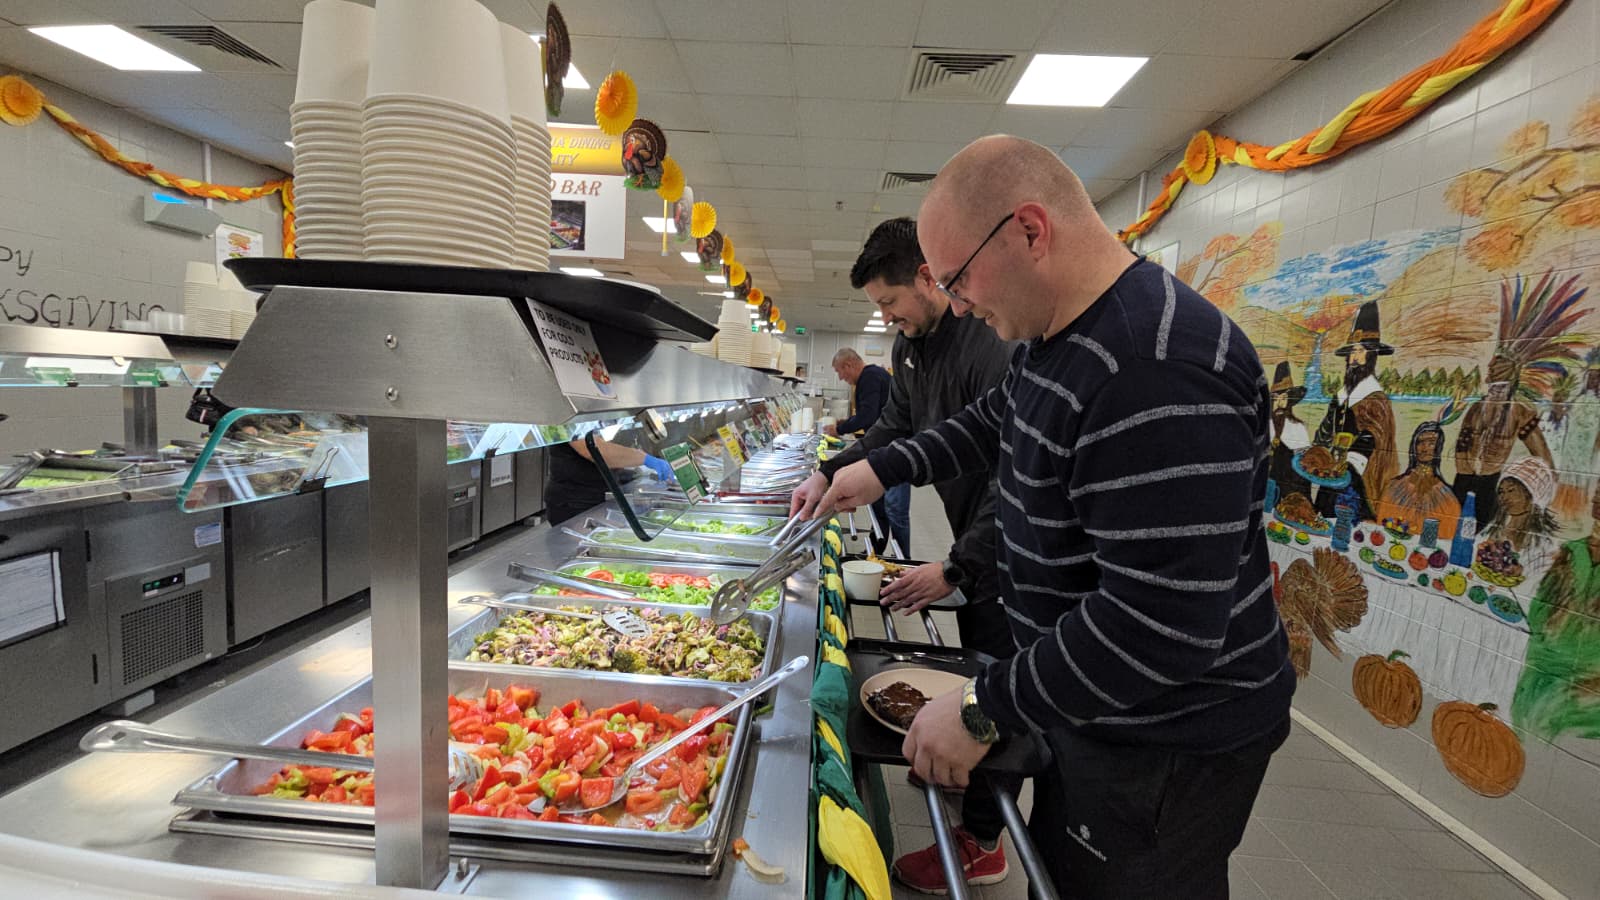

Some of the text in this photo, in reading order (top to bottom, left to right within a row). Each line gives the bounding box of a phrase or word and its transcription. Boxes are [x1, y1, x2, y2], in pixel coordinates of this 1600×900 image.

[568, 135, 611, 150] DINING
[560, 179, 602, 197] BAR
[534, 308, 545, 320] TO
